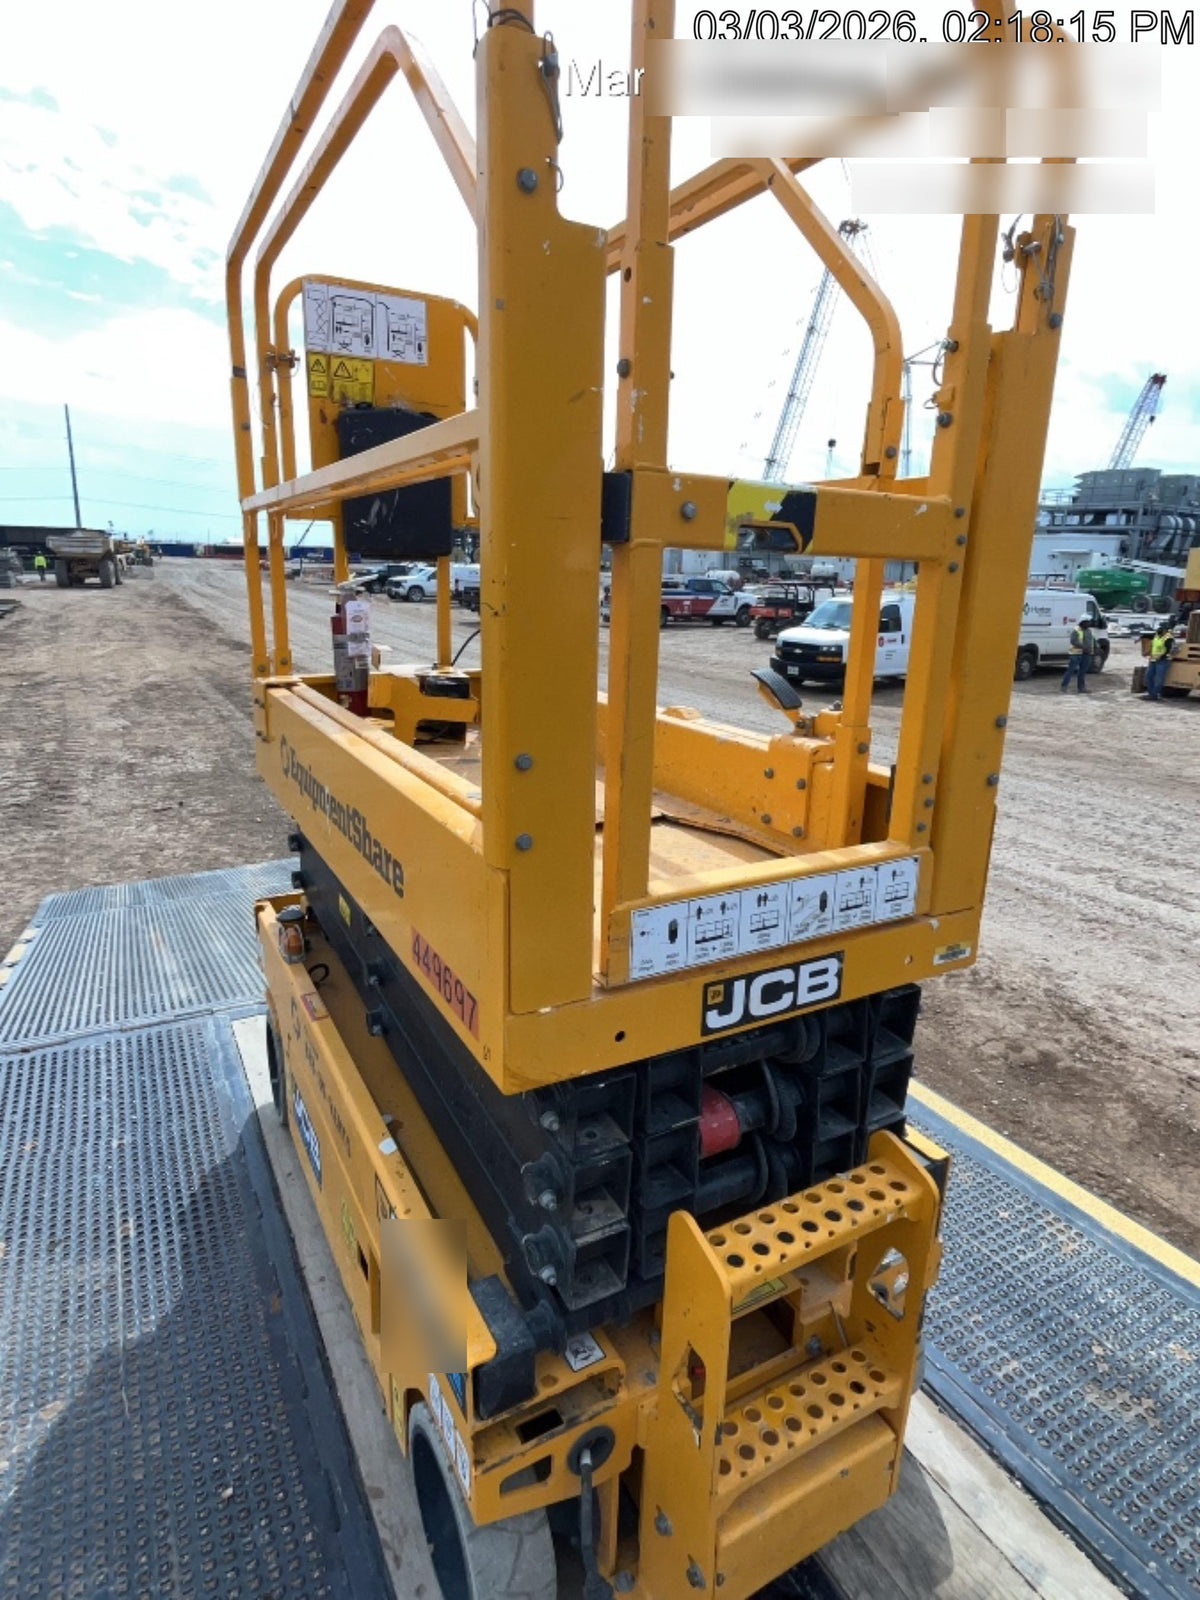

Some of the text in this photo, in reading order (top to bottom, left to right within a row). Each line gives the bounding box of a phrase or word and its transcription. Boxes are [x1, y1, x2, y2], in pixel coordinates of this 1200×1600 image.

[289, 746, 405, 899] EquipmentShare
[412, 933, 477, 1032] 449697
[705, 958, 840, 1029] JCB
